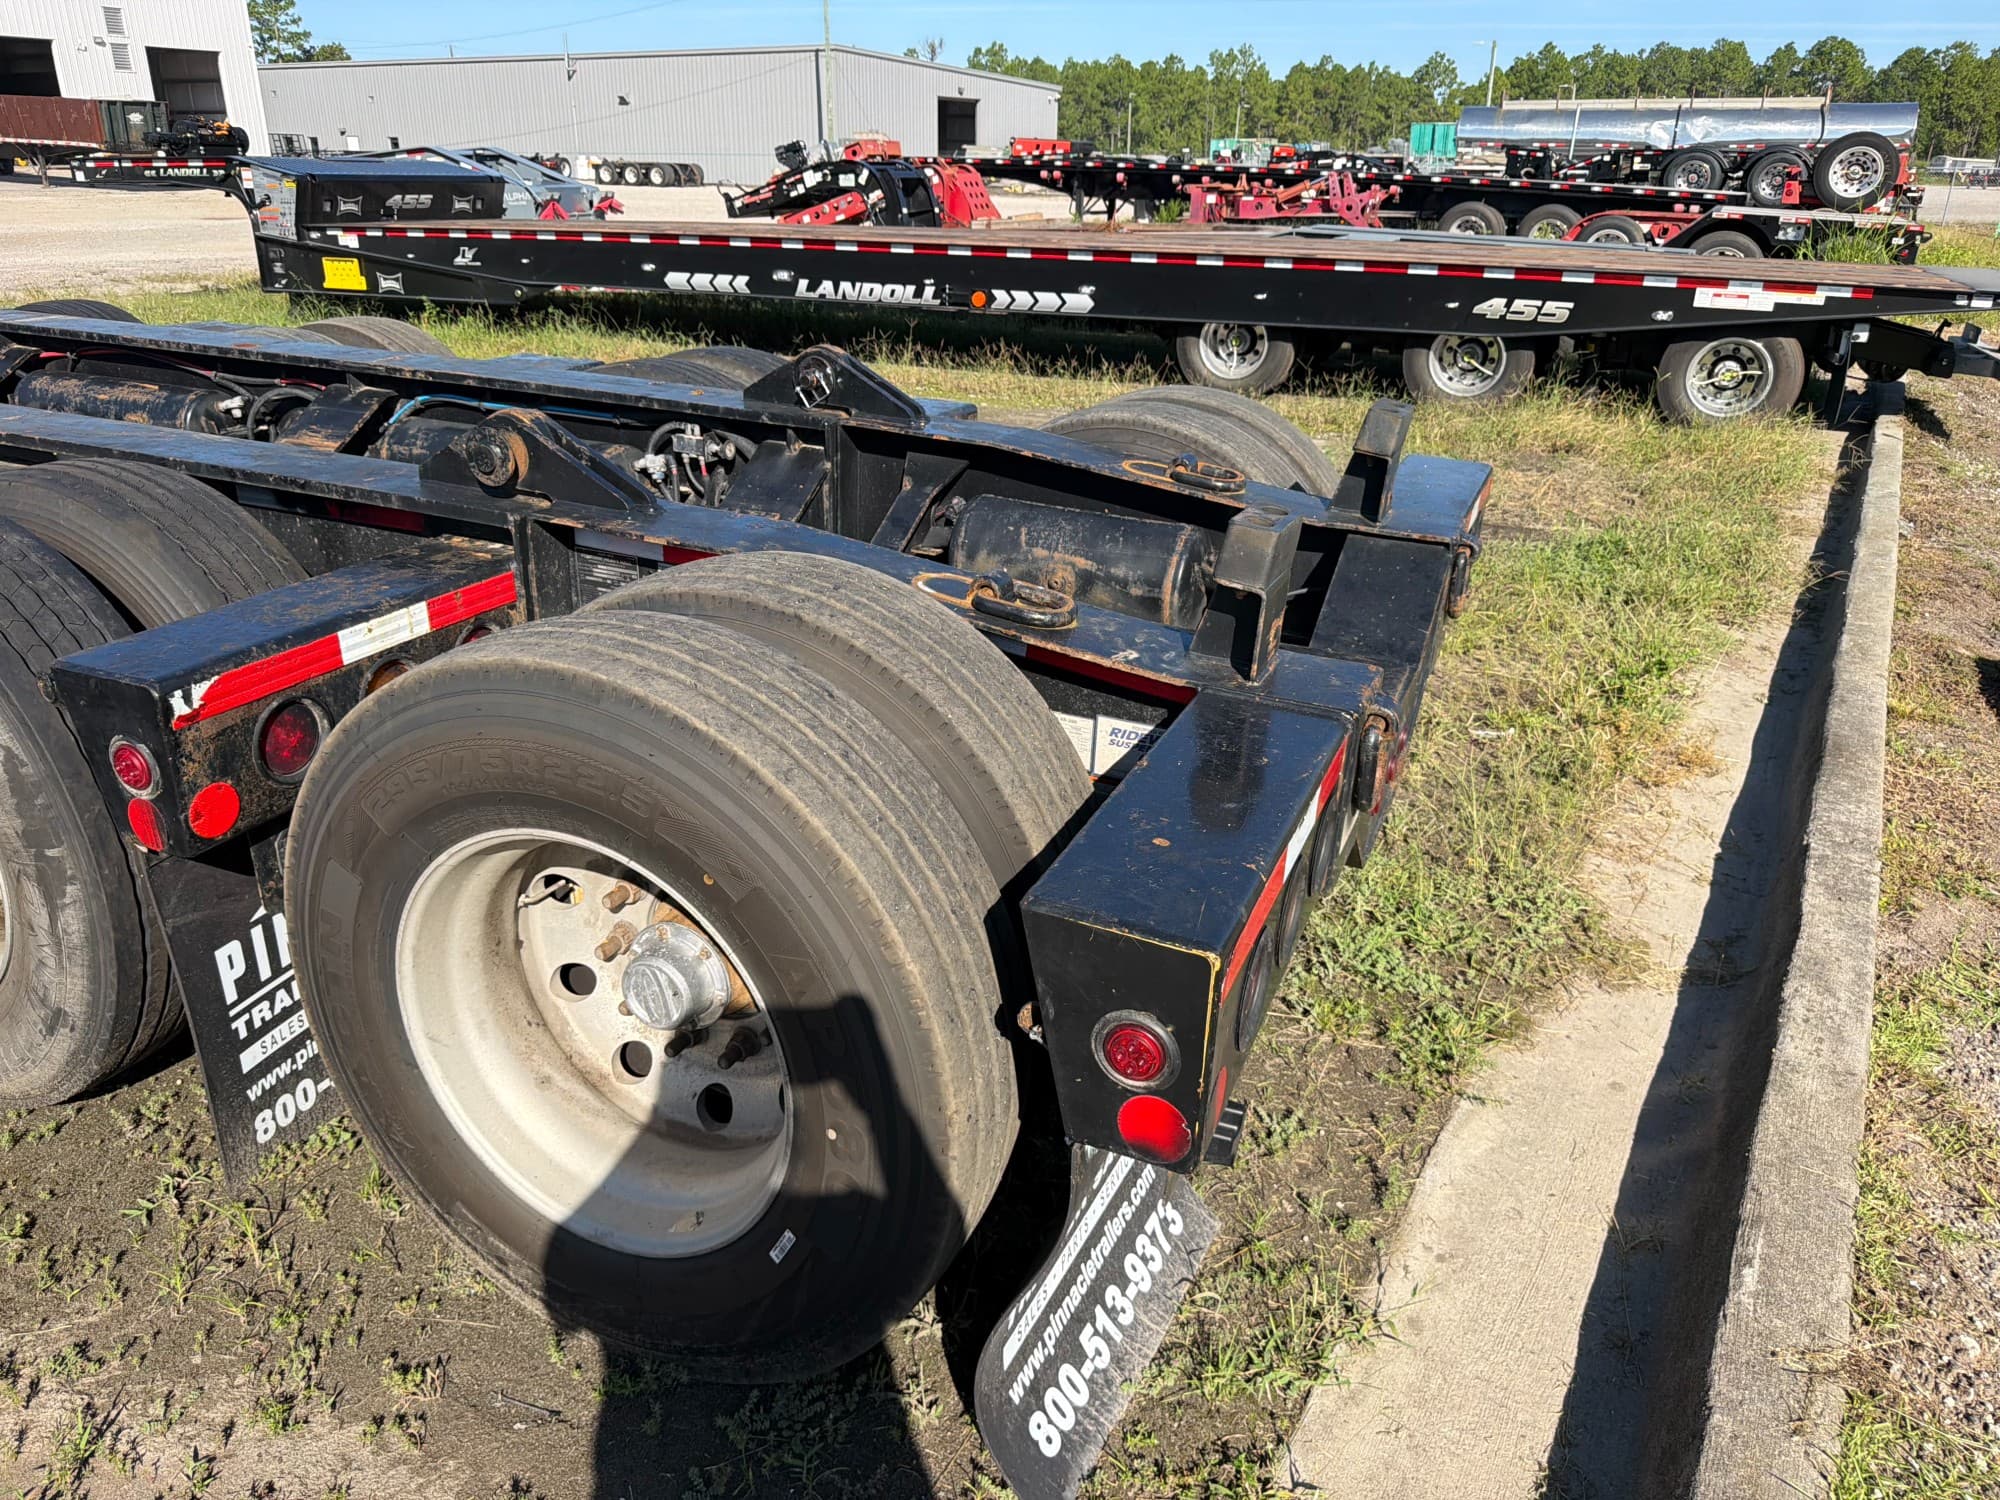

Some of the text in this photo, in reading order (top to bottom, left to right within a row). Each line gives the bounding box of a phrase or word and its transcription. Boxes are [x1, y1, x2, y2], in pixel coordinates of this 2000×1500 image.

[159, 168, 209, 177] LANDOLL
[384, 194, 434, 209] 455
[794, 278, 941, 305] LANDOLL
[1472, 297, 1575, 323] 455
[259, 1014, 306, 1056] SALES
[1008, 1163, 1156, 1406] www.pinnacletrailers.com
[1016, 1283, 1049, 1344] SALES
[1060, 1220, 1089, 1273] PARTS
[1028, 1198, 1184, 1458] 800-513-9373
